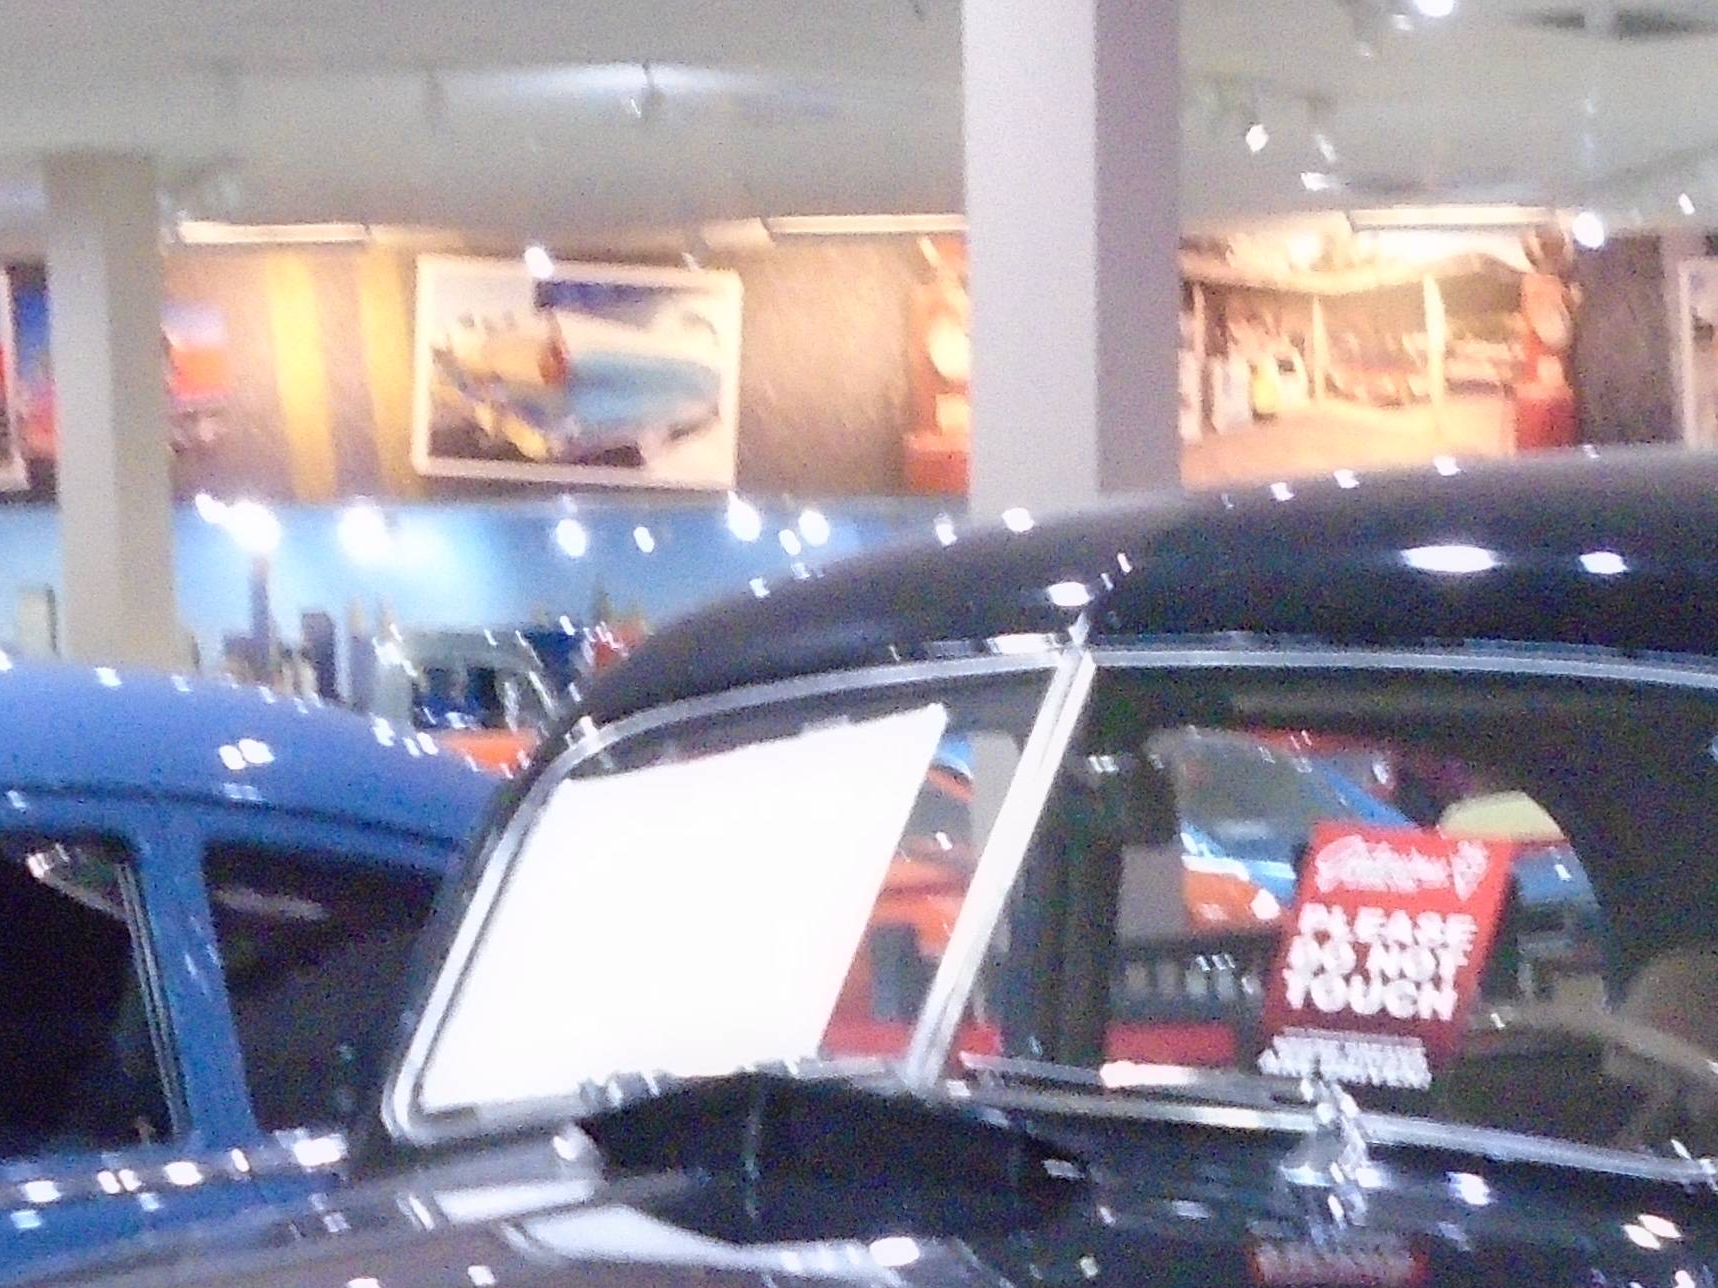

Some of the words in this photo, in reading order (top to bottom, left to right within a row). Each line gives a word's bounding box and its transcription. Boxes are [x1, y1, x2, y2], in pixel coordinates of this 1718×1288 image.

[1299, 902, 1477, 950] PLEASE
[1288, 935, 1356, 975] DO
[1366, 940, 1468, 983] NOT
[1283, 969, 1457, 1020] TOUCH
